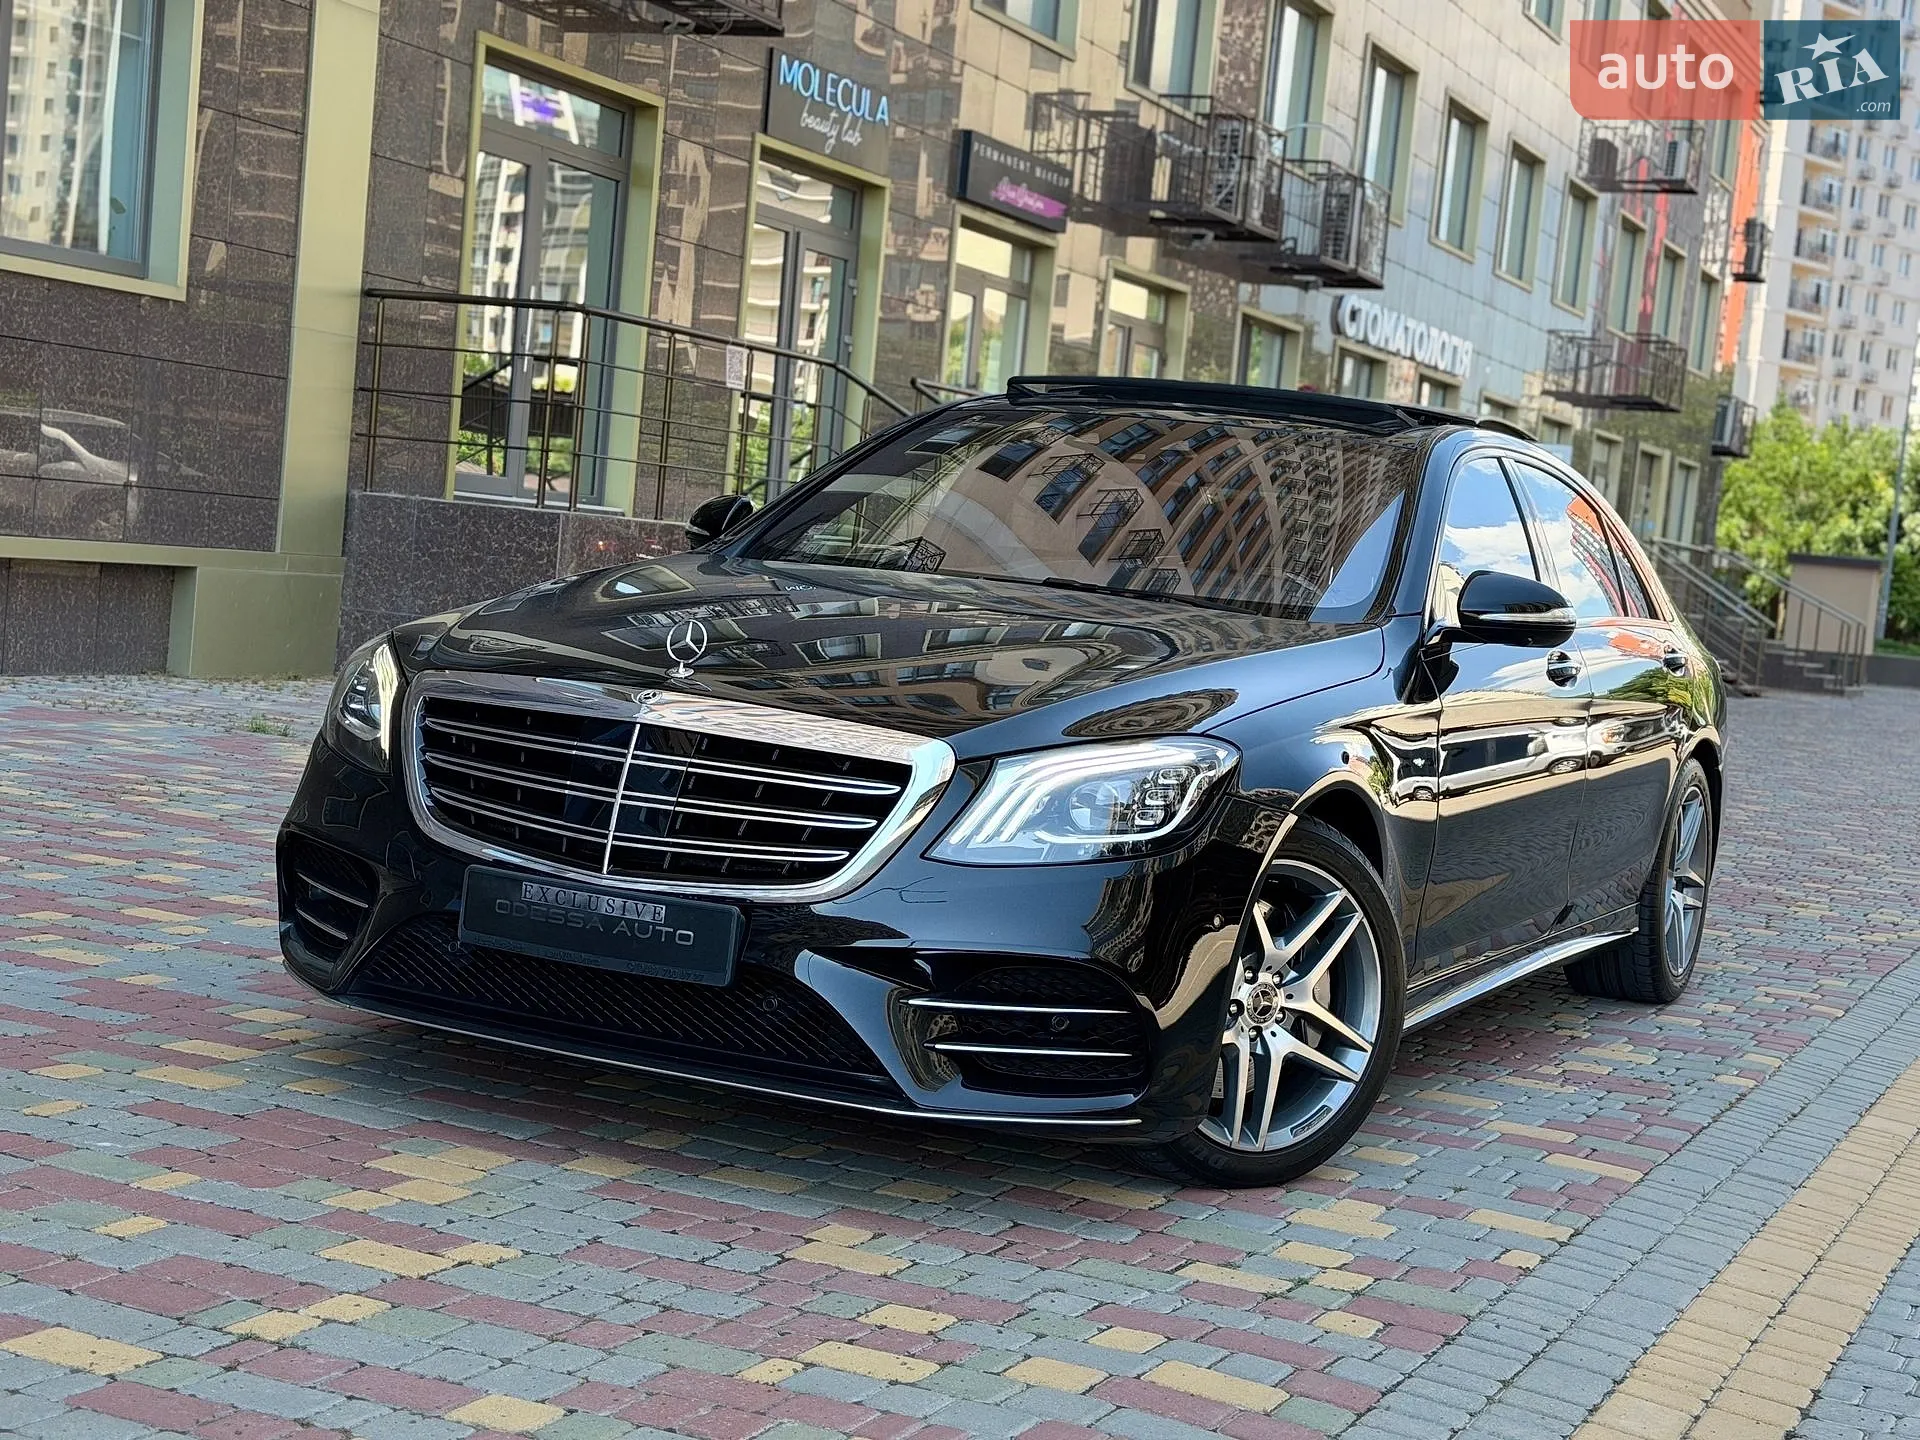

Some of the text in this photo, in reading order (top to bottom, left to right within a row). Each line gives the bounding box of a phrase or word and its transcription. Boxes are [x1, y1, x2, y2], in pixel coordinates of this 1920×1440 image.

[779, 54, 889, 127] MOLECULA
[800, 99, 863, 154] beauty lab
[974, 142, 1070, 188] PERMANENT MAKEUP
[1341, 294, 1473, 379] СТОМАТОЛОГІЯ
[495, 899, 695, 946] ODESSA AUTO
[522, 884, 664, 922] EXCLUSIVE
